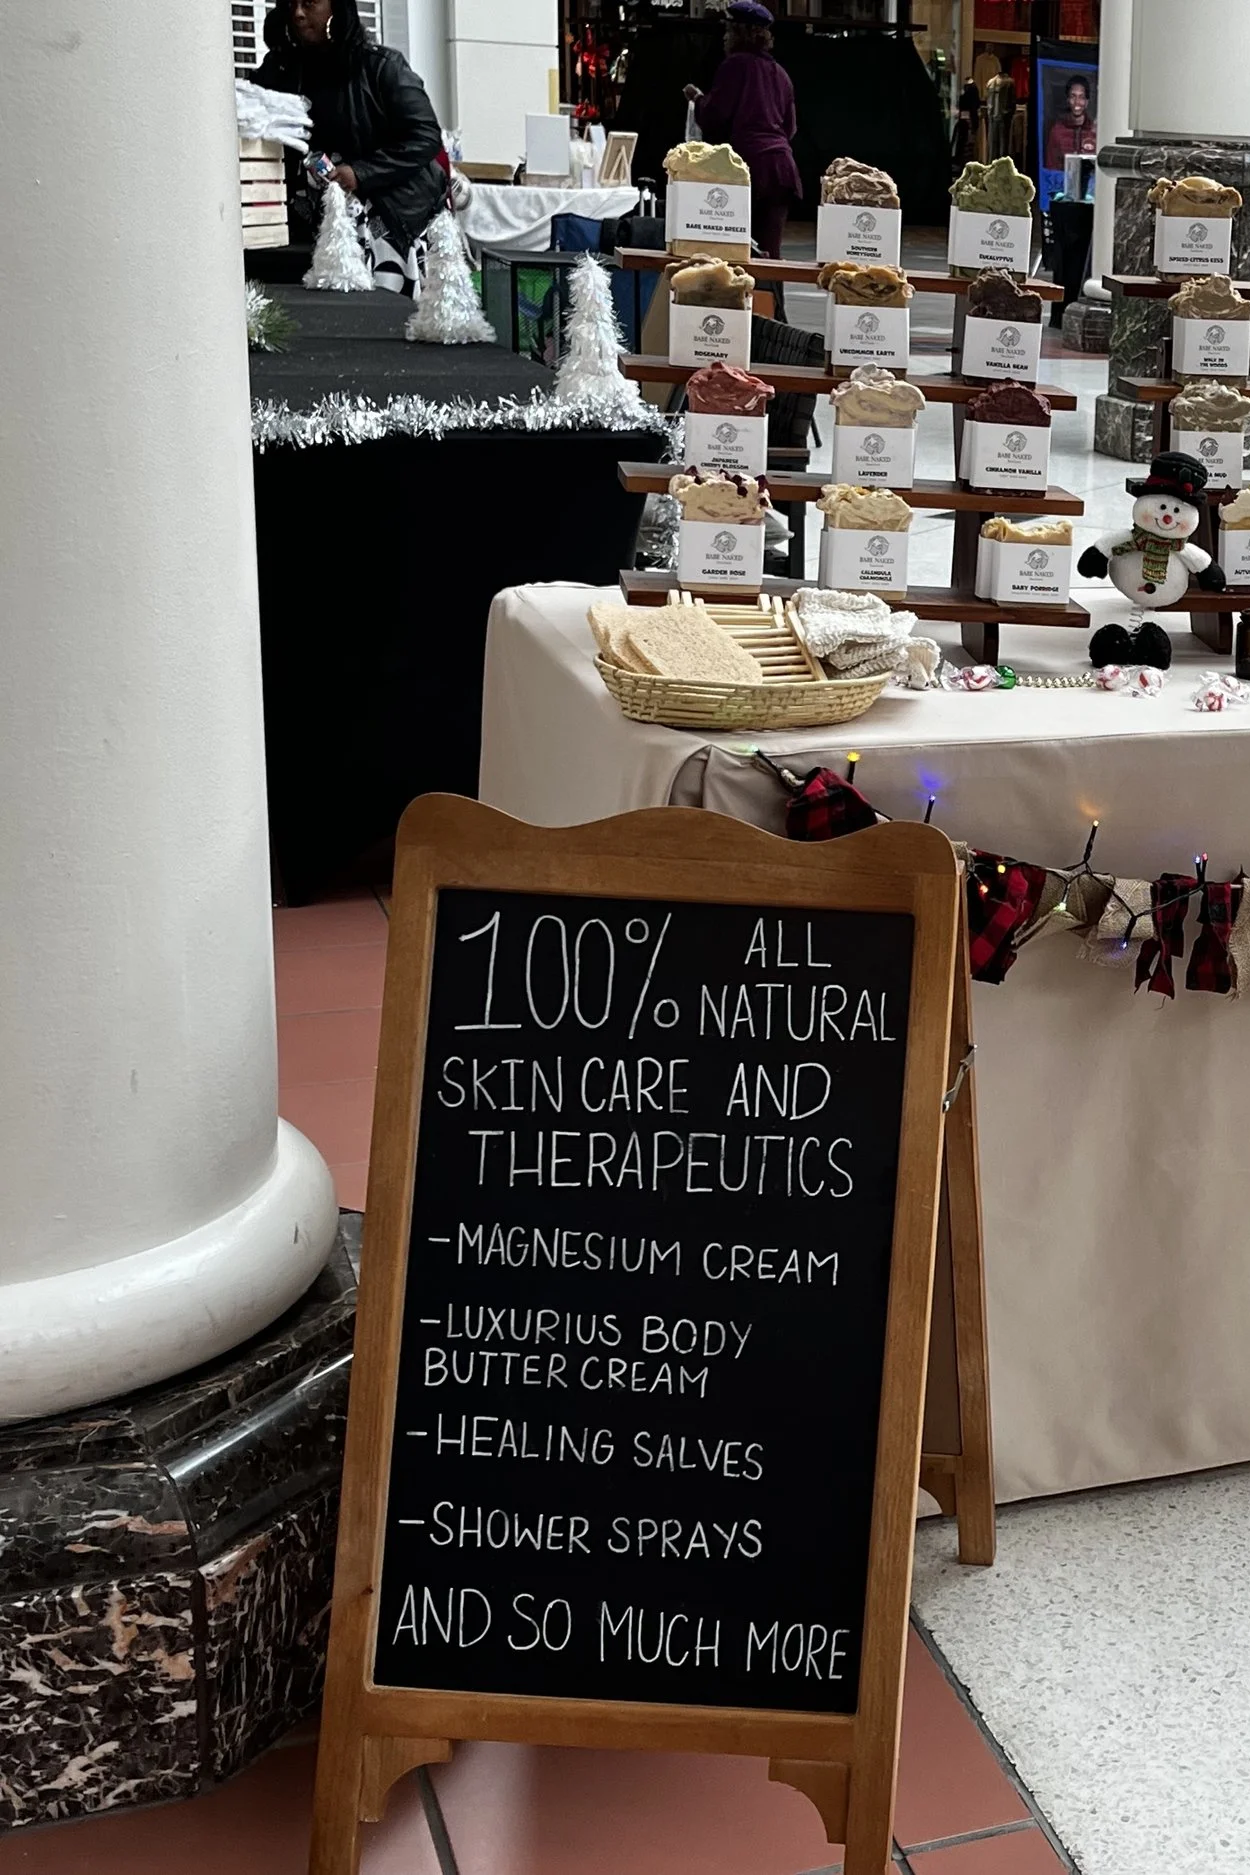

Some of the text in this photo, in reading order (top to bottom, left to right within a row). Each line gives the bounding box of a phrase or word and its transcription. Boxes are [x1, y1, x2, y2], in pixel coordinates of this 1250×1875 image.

[714, 210, 735, 218] NAKED
[862, 233, 882, 241] NAKED
[694, 351, 729, 359] ROSEMARY
[986, 361, 1011, 369] VANILLA
[1006, 348, 1026, 356] NAKED
[985, 466, 1042, 476] CINNAMON VANILLA
[454, 911, 832, 1040] 100% ALL
[700, 984, 896, 1042] NATURAL
[727, 1063, 831, 1120] AND
[468, 1130, 853, 1197] THERAPEUTICS
[703, 1242, 839, 1286] CREAM
[642, 1315, 753, 1359] BODY
[424, 1348, 709, 1398] BUTTER CREAM
[633, 1431, 764, 1480] SALVES
[607, 1518, 763, 1560] SPRAYS
[392, 1584, 851, 1680] AND SO MUCH MORE
